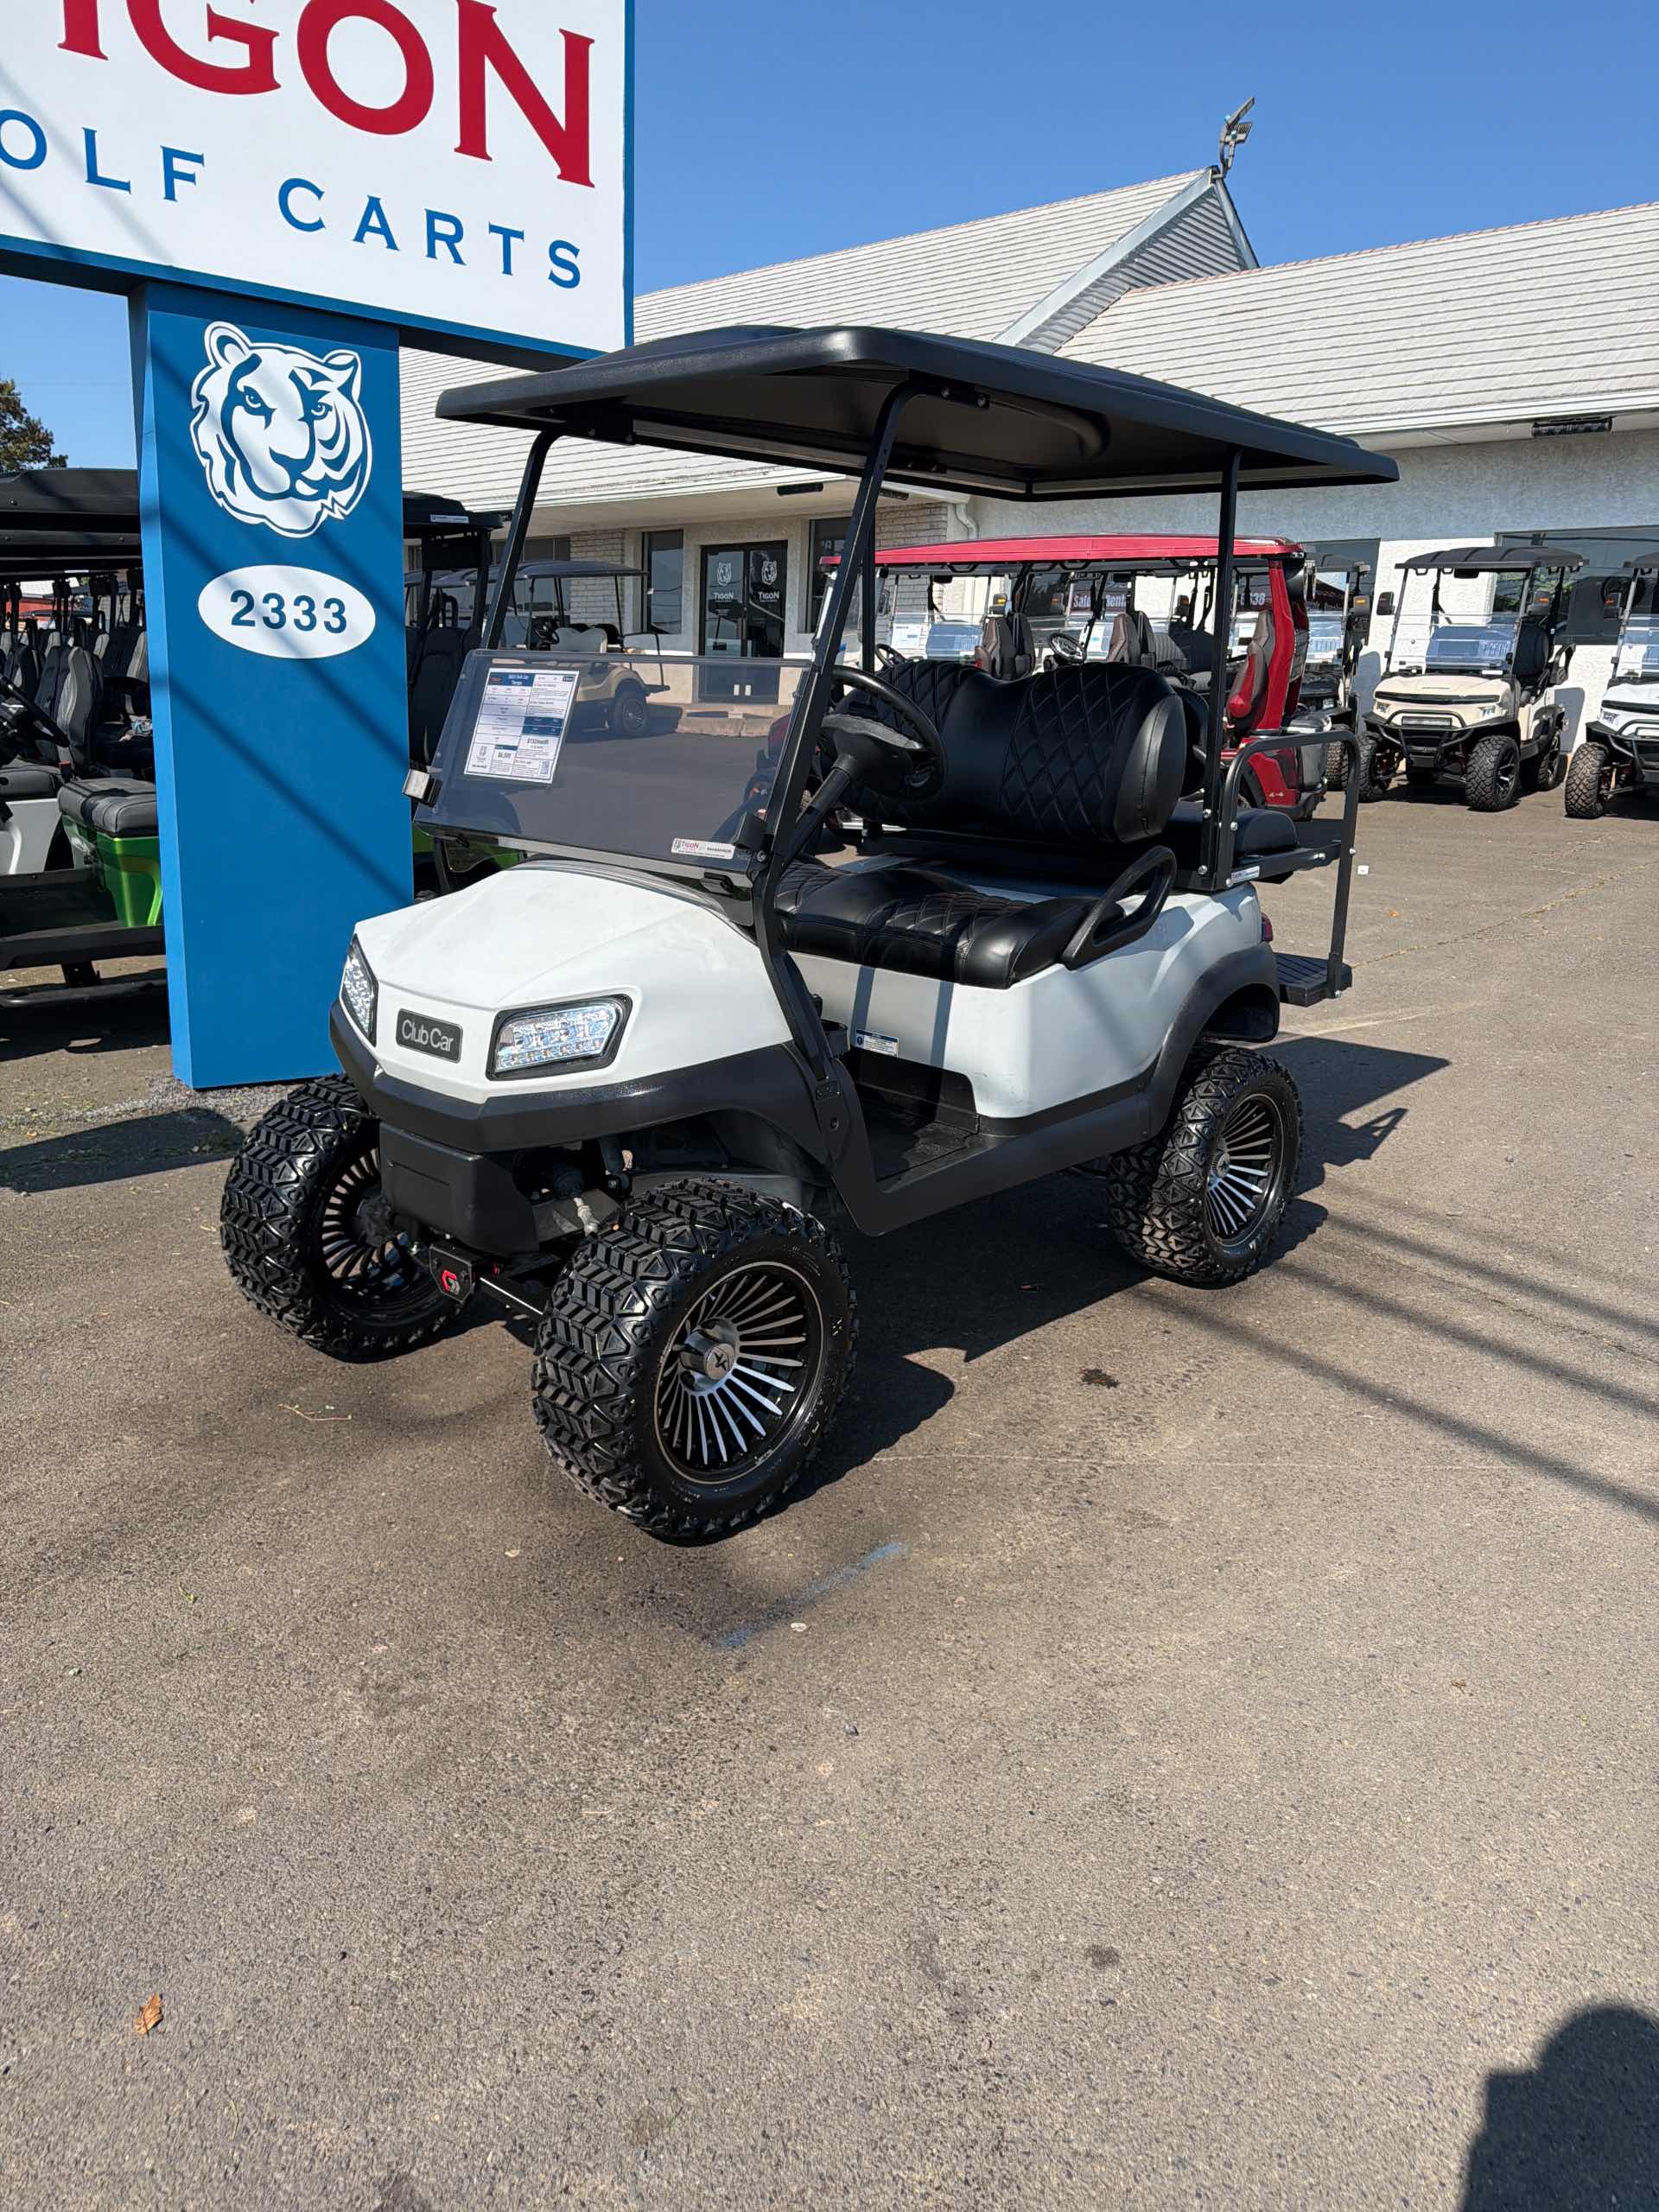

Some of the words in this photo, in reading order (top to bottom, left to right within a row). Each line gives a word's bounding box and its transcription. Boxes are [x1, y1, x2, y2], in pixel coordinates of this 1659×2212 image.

[0, 109, 205, 202] OLF
[278, 177, 581, 289] CARTS
[230, 589, 346, 633] 2333
[402, 1020, 429, 1046] Club
[430, 1028, 454, 1052] Car
